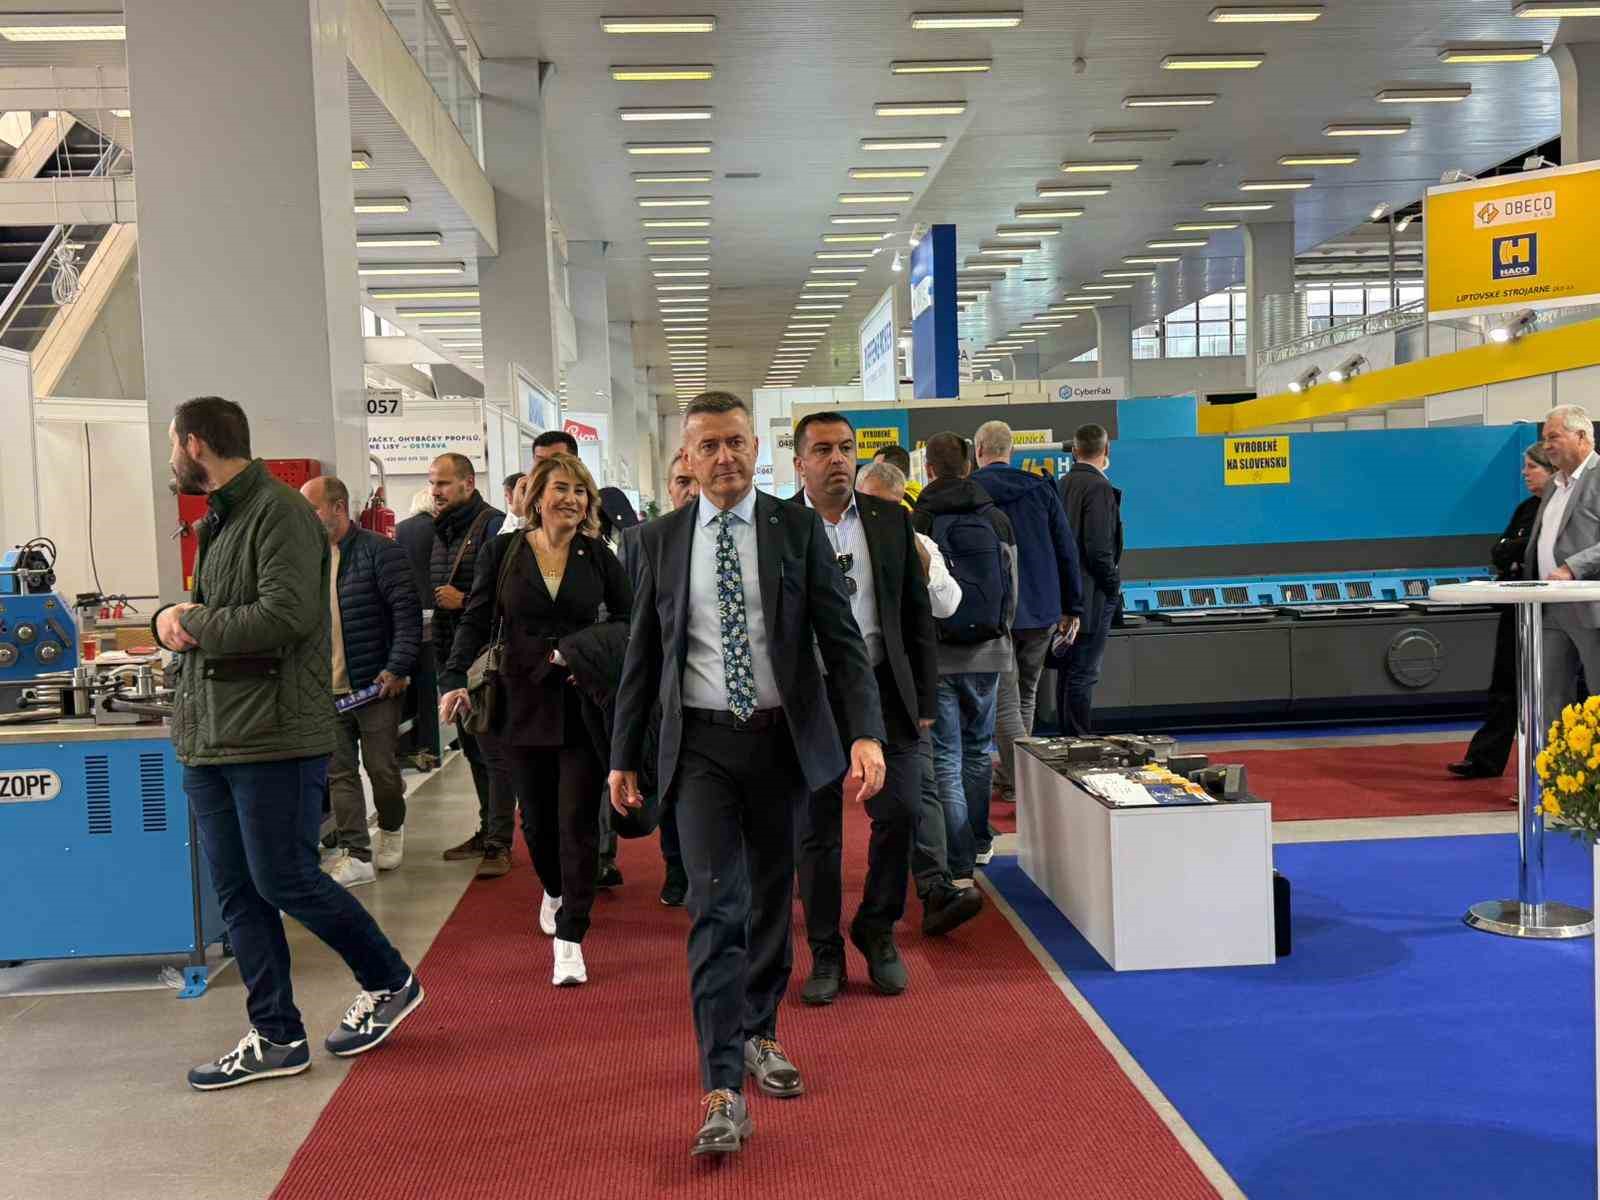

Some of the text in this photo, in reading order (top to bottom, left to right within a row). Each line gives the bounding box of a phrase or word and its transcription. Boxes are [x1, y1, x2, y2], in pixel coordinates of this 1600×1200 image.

[1505, 197, 1551, 215] OBECO
[1074, 387, 1111, 397] CyberFab
[367, 399, 398, 414] 057
[1226, 456, 1287, 470] NA SLOVENSKU
[0, 775, 51, 797] ZOPF
